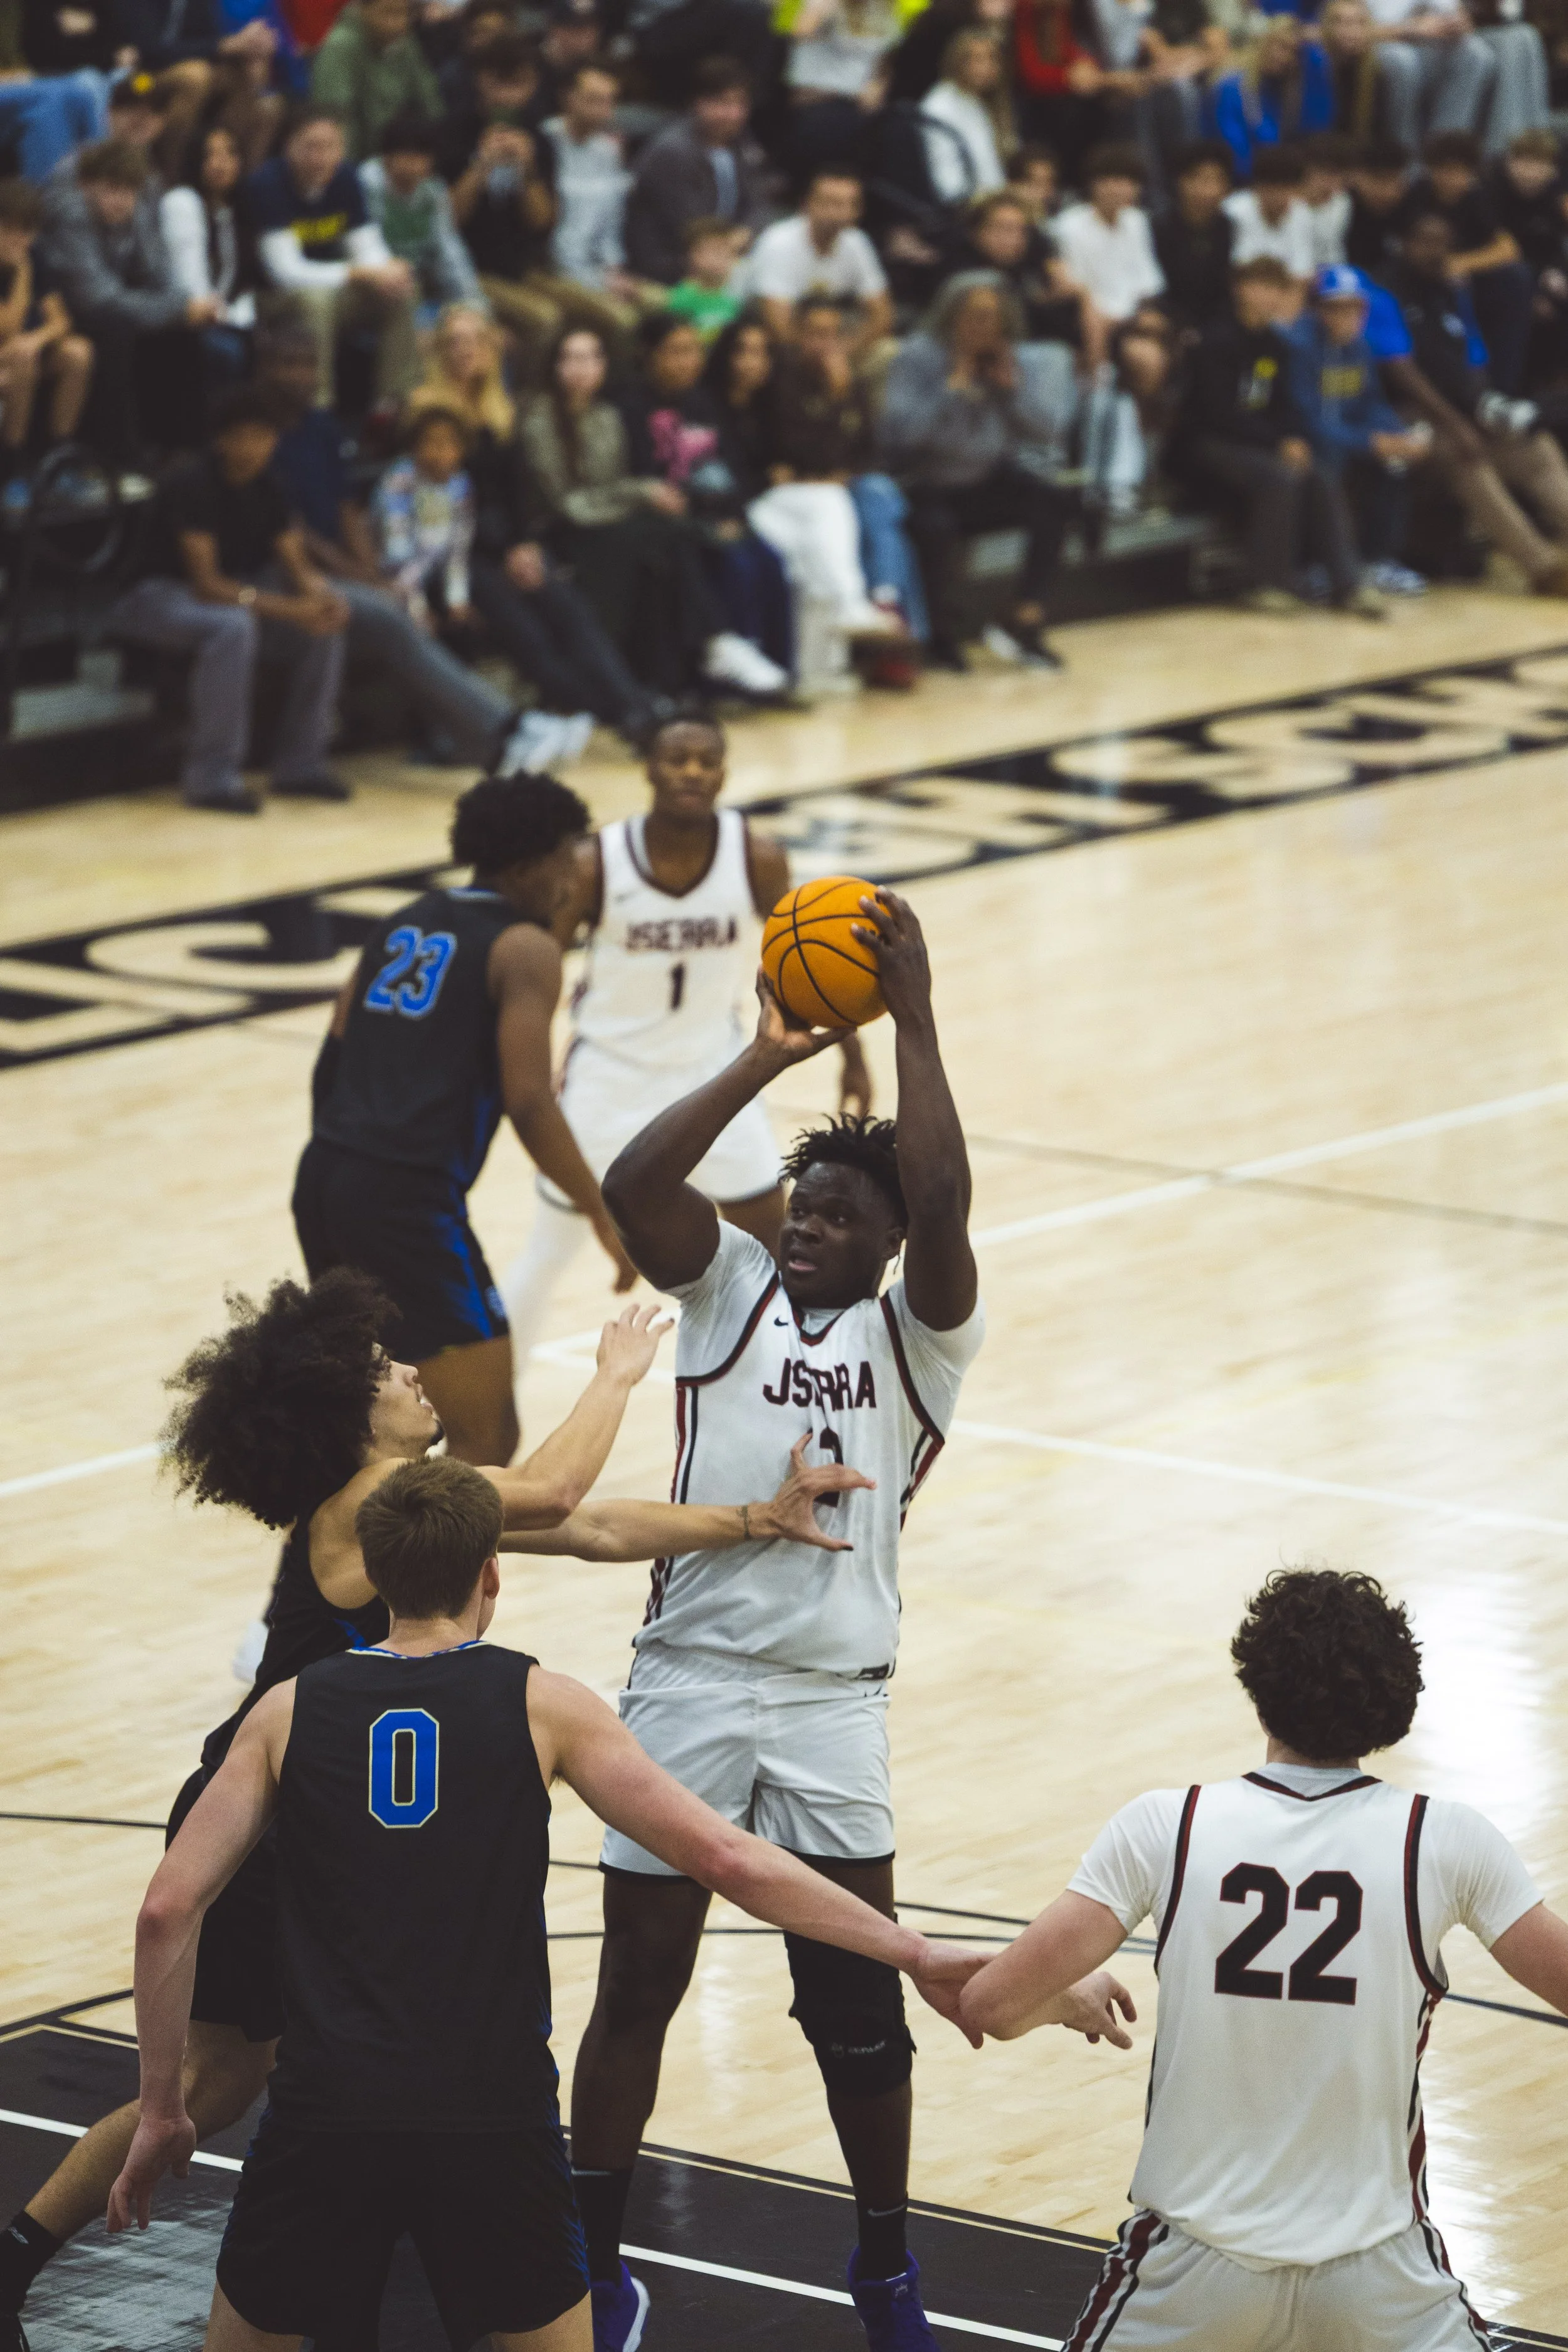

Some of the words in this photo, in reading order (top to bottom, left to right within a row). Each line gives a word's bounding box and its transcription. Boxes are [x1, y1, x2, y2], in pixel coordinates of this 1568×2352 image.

[363, 926, 457, 1019] 23
[669, 963, 686, 1012] 1
[763, 1358, 876, 1412] JSRRA
[369, 1708, 440, 1828] 0
[1214, 1862, 1363, 2006] 22
